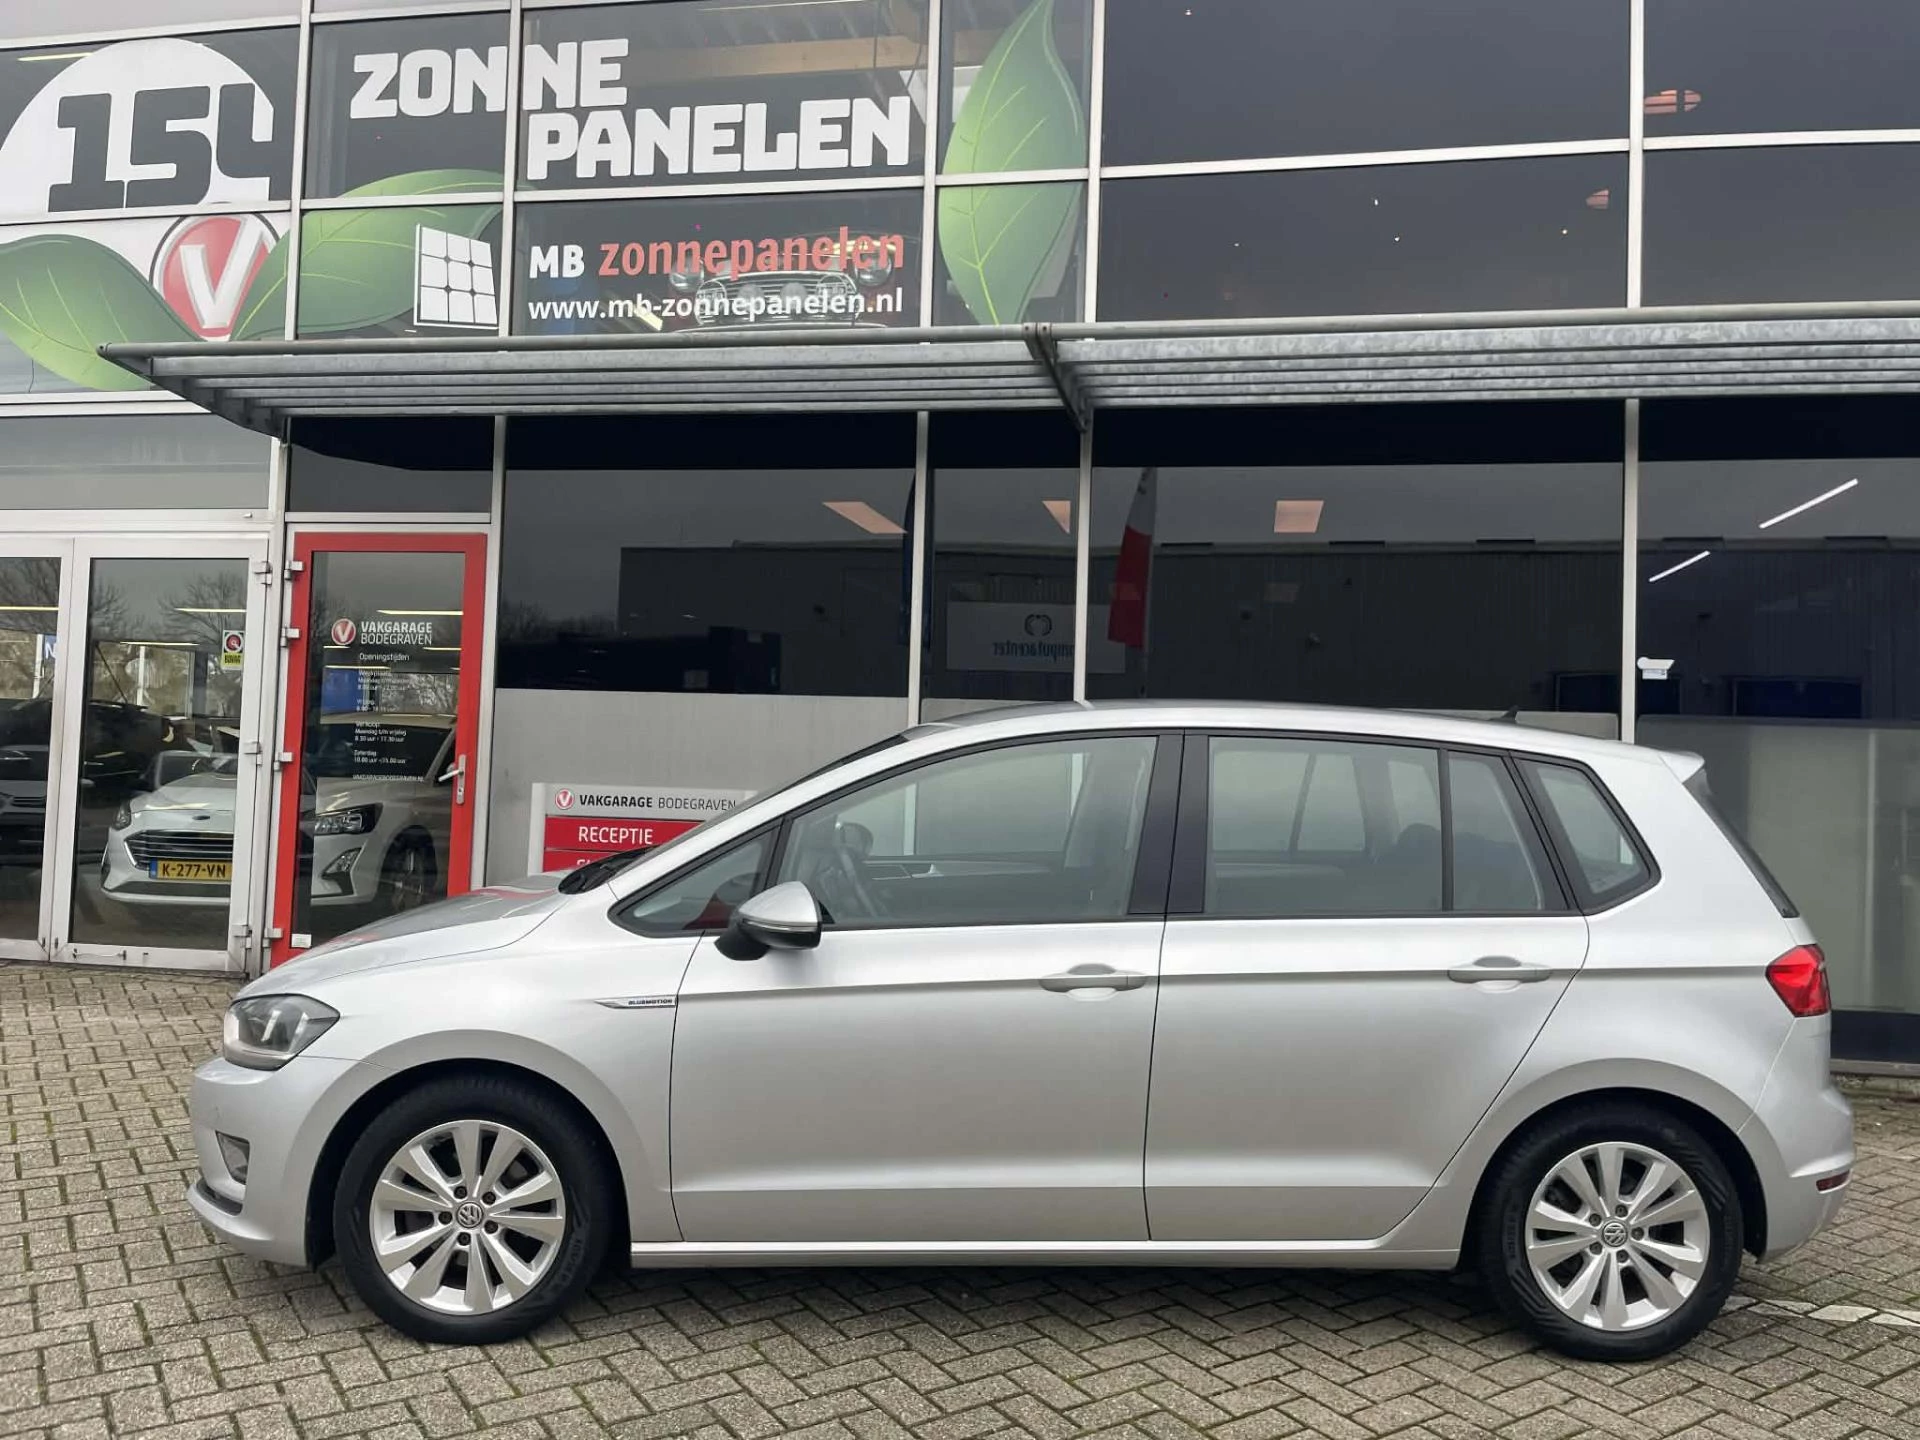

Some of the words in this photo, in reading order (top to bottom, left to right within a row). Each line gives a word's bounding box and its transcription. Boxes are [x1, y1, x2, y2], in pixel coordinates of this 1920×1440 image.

[350, 38, 629, 119] ZONNE
[48, 82, 275, 213] 154
[527, 95, 911, 181] PANELEN
[529, 244, 585, 279] MB
[598, 225, 905, 282] zonnepanelen
[528, 287, 904, 325] www.mb-zonnepanelen.nl
[360, 633, 433, 646] BODEGRAVEN
[361, 621, 433, 634] VAKGARAGE
[579, 794, 653, 808] VAKGARAGE
[658, 797, 736, 811] BODEGRAVEN
[578, 826, 653, 845] RECEPTIE
[162, 863, 226, 878] K-277-VN
